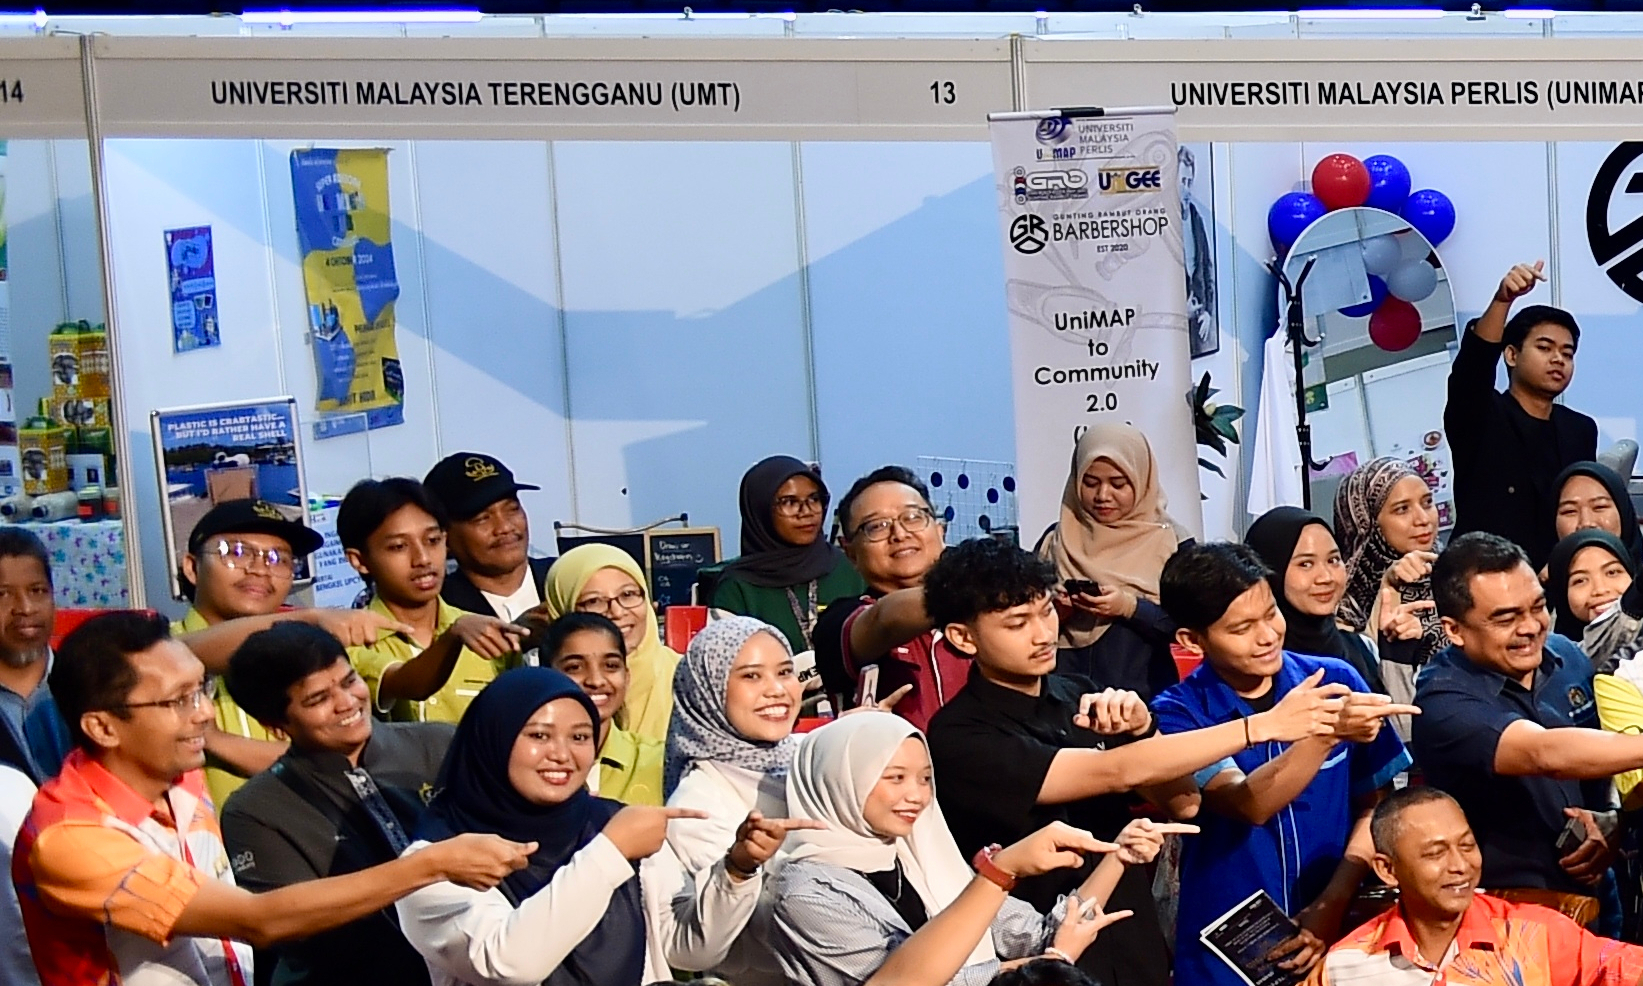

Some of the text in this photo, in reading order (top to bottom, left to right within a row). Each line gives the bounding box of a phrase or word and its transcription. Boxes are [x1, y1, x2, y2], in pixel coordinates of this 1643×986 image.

[0, 79, 24, 103] 14
[211, 80, 740, 112] UNIVERSITI MALAYSIA TERENGGANU (UMT)
[930, 80, 956, 105] 13
[1171, 81, 1310, 107] UNIVERSITI
[1317, 81, 1445, 105] MALAYSIA
[1451, 80, 1539, 105] PERLIS
[1078, 123, 1133, 133] UNIVERSITI
[1079, 134, 1129, 143] MALAYSIA
[1080, 145, 1113, 155] PERLIS
[1053, 217, 1168, 241] BARBERSHOP
[1110, 244, 1128, 252] 2020
[1055, 309, 1135, 330] UniMAP
[1088, 339, 1109, 356] to
[1034, 359, 1159, 384] Community
[1086, 393, 1118, 412] 2.0
[168, 421, 206, 431] PLASTIC
[209, 419, 218, 427] IS
[176, 430, 195, 439] BUT
[211, 424, 248, 436] RATHER
[250, 422, 275, 431] HAVE
[232, 433, 256, 442] REAL
